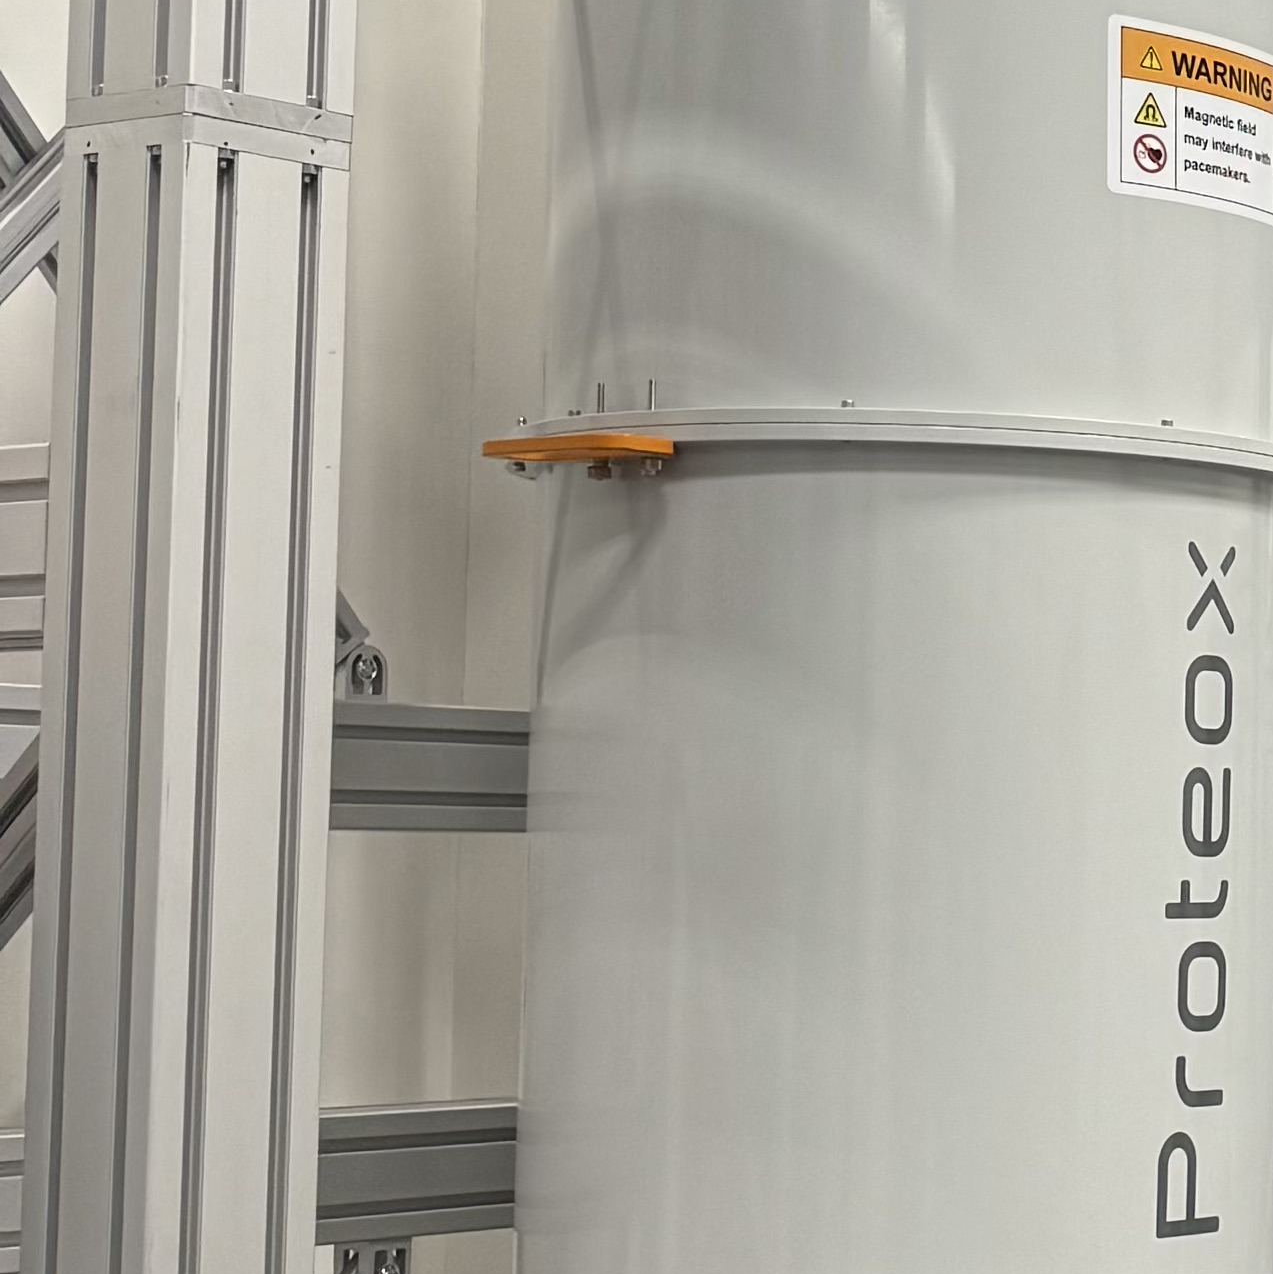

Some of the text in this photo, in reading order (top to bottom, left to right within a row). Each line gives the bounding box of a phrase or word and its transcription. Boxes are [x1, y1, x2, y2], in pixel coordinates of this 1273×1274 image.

[1172, 50, 1272, 102] WARNING
[1184, 105, 1257, 136] Magnetic field
[1184, 133, 1272, 166] may interfere with
[1184, 158, 1251, 183] pacemakers.
[1156, 541, 1236, 1239] Proteox
